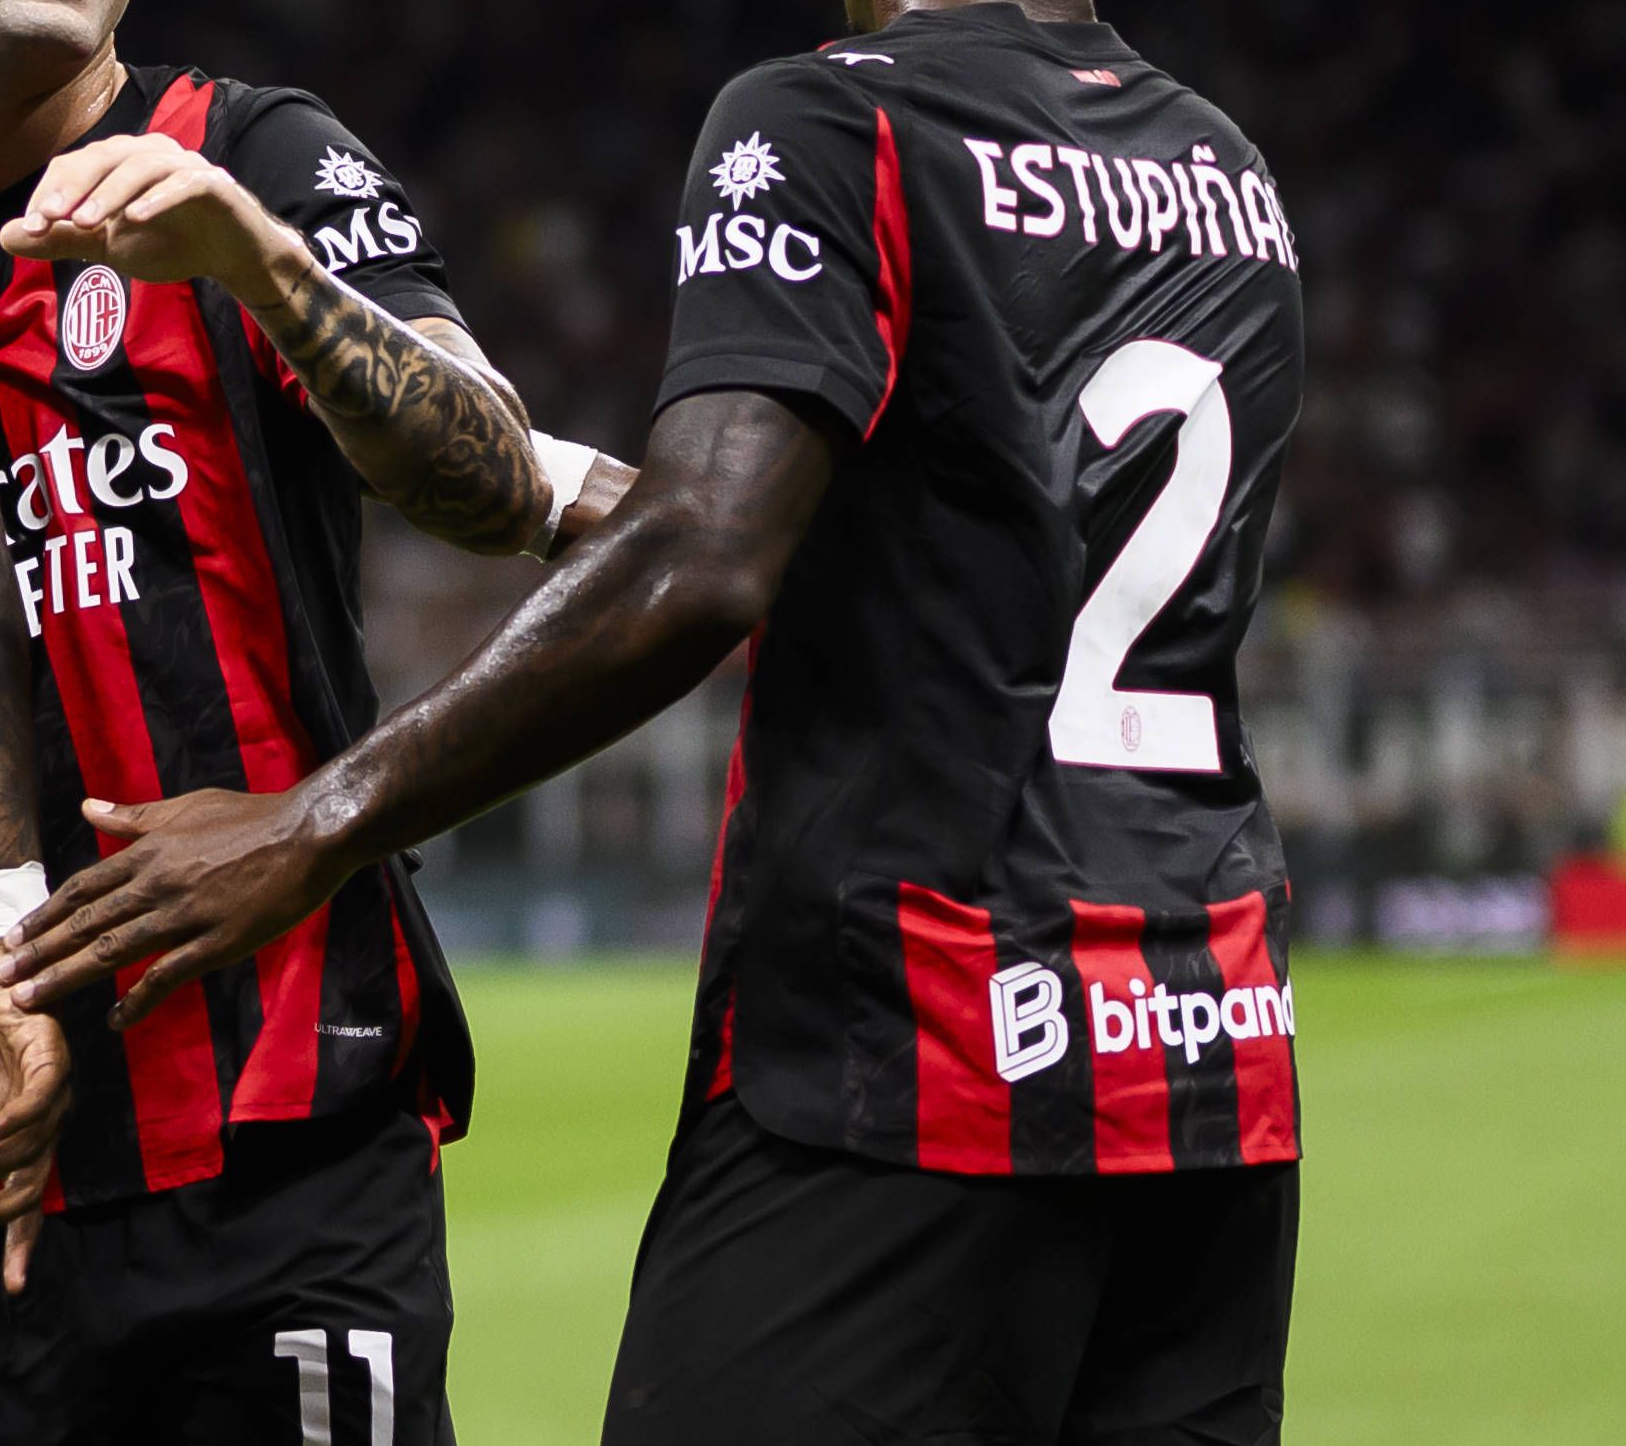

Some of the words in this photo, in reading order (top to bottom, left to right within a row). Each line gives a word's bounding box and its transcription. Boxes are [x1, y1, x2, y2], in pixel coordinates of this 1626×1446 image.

[313, 201, 423, 274] MS
[676, 212, 823, 286] MSC
[78, 342, 108, 359] 1899
[1049, 338, 1232, 772] 2
[314, 1022, 383, 1038] ULTRAWEAVE
